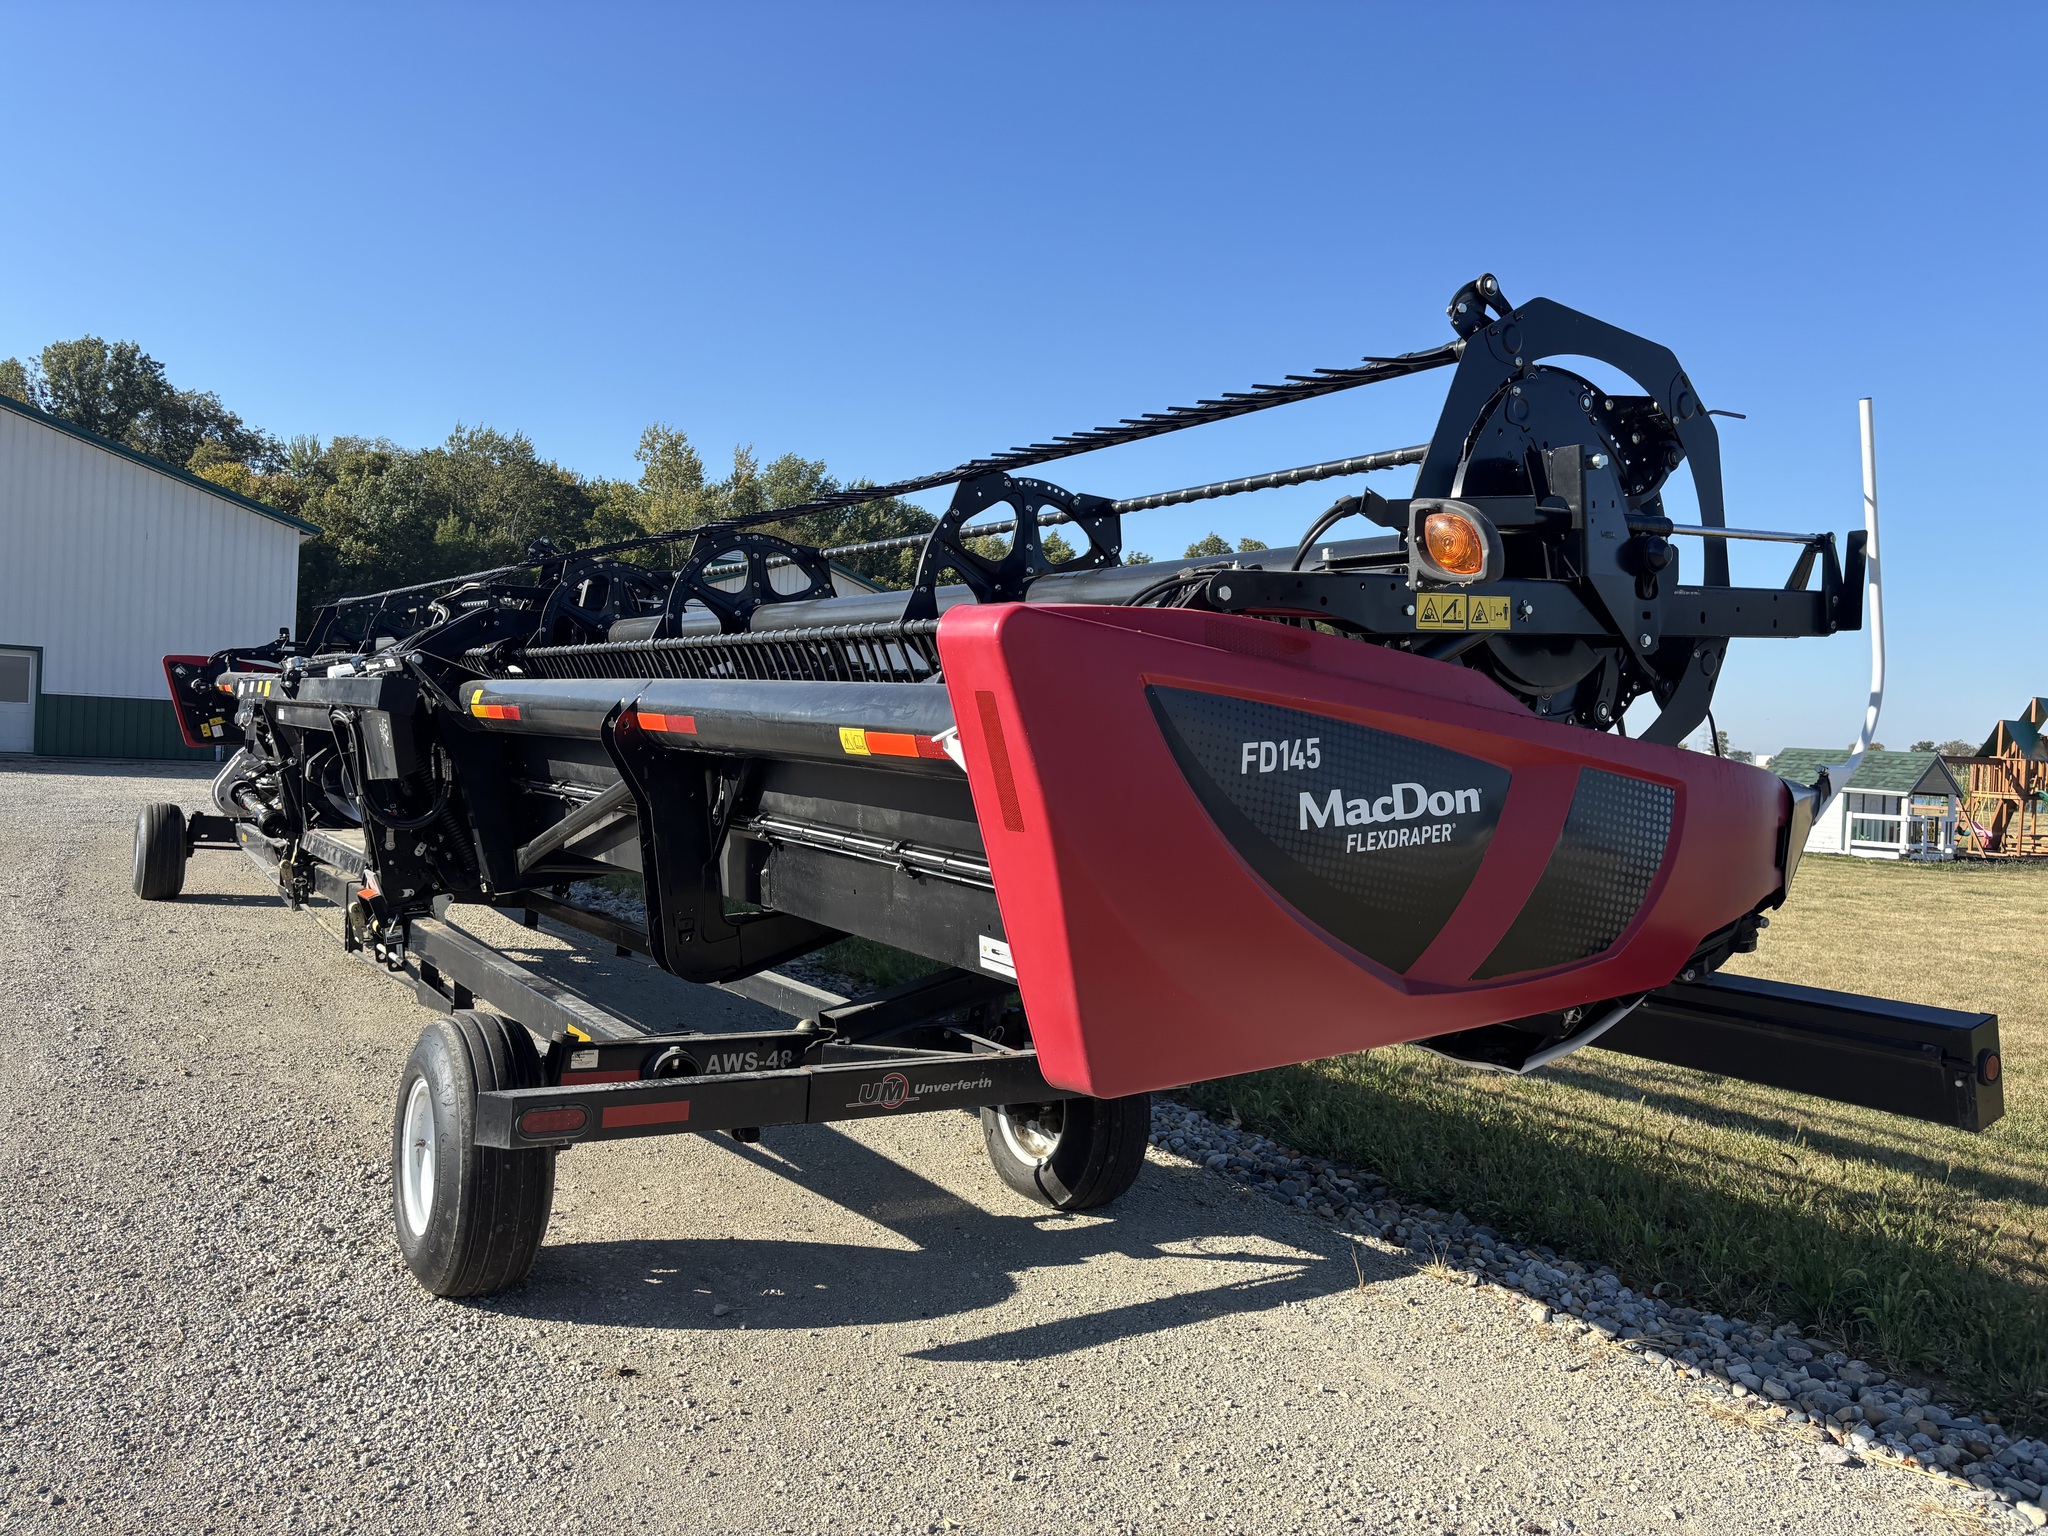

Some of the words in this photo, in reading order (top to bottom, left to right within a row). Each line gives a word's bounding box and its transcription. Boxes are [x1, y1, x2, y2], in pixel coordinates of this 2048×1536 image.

[1241, 737, 1321, 775] FD145
[1299, 782, 1481, 830] MacDon
[1346, 824, 1452, 853] FLEXDRAPER
[705, 1050, 792, 1073] AWS-48
[914, 1077, 992, 1094] Unverferth
